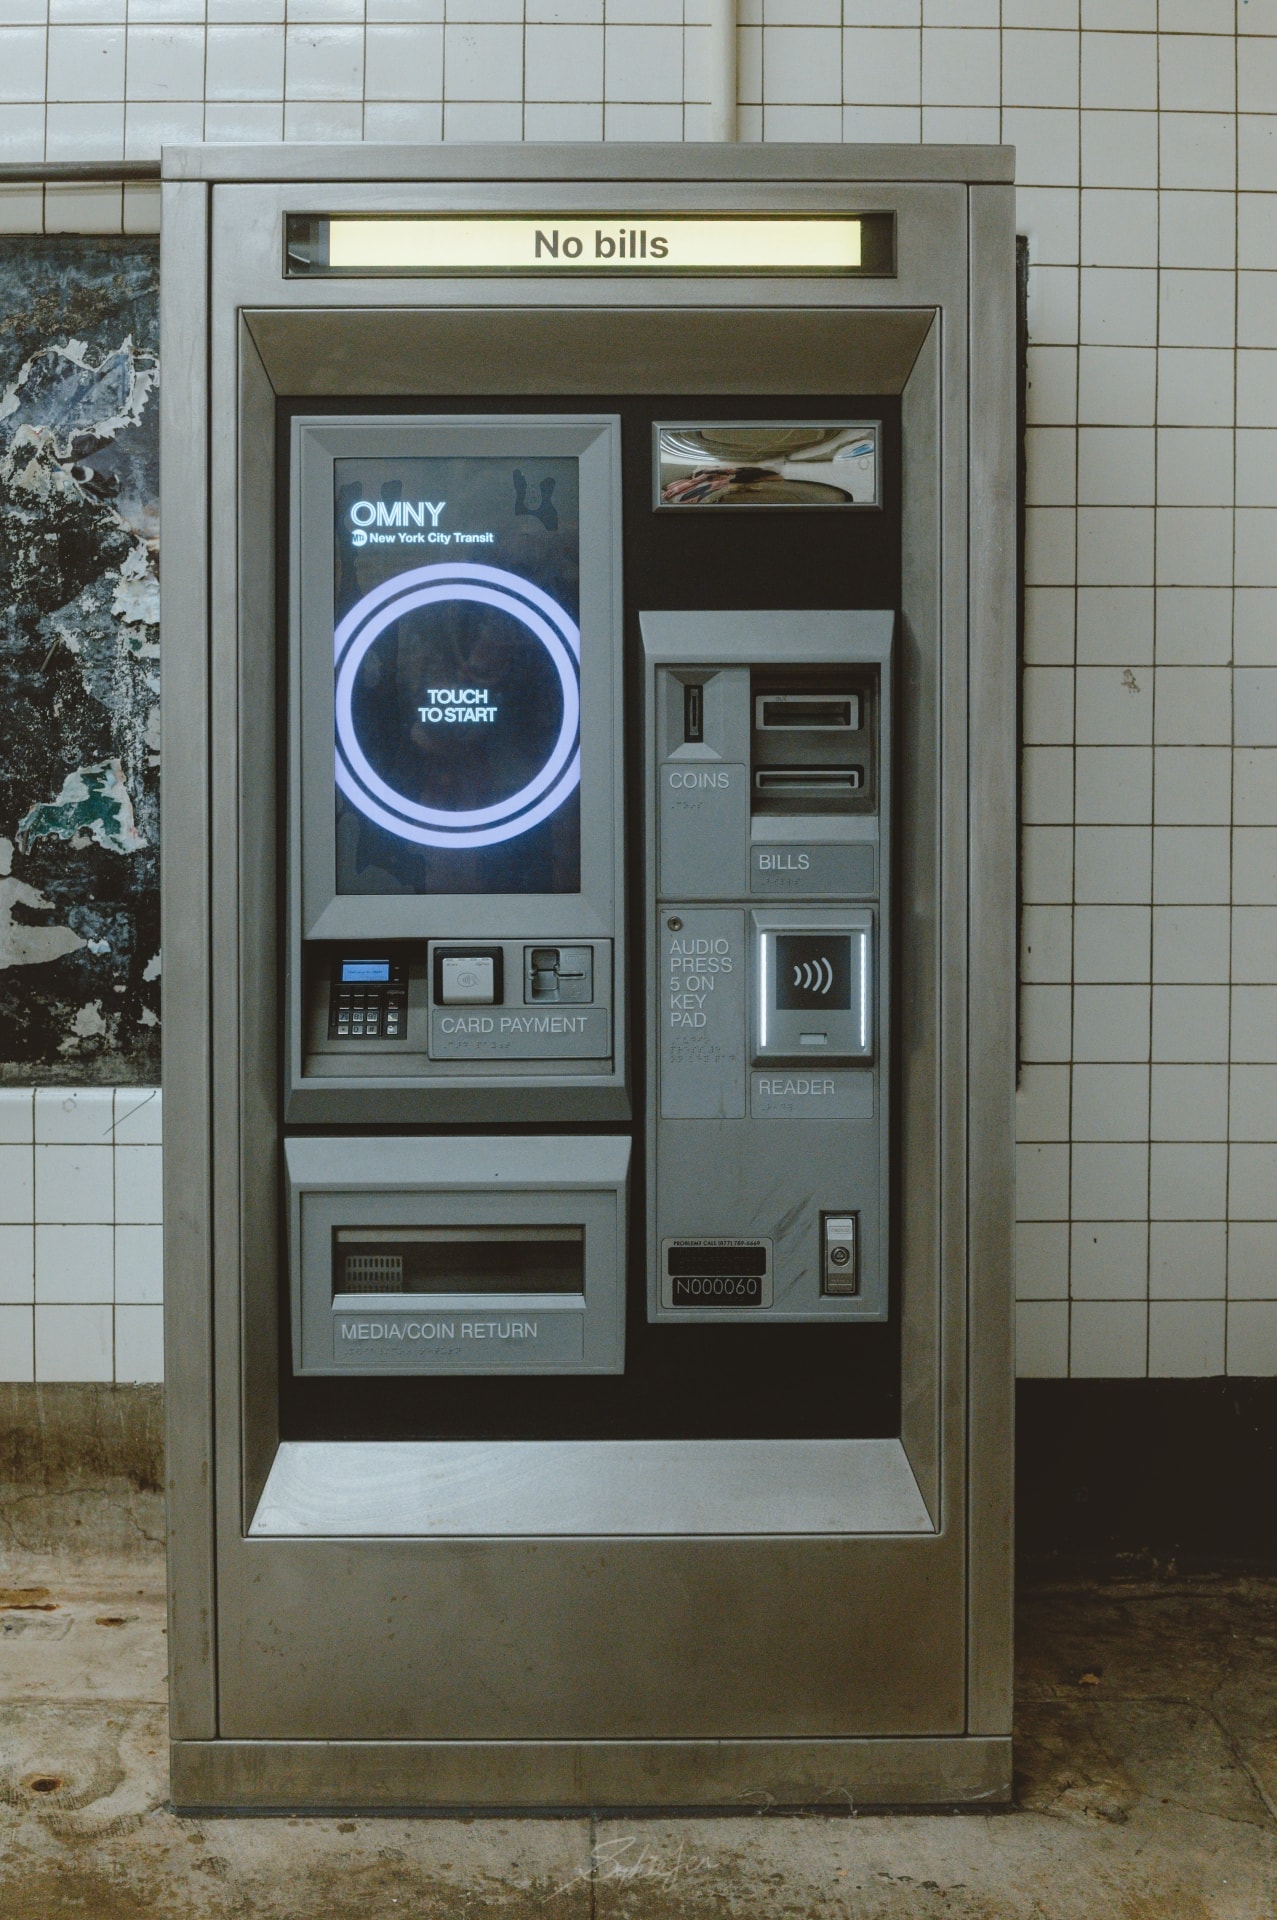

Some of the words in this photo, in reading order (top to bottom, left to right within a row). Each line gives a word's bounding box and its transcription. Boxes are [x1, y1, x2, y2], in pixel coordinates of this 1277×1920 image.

[535, 230, 583, 259] No
[595, 228, 669, 259] bills
[350, 501, 446, 527] OMNY
[369, 532, 395, 543] New
[397, 532, 425, 543] York
[428, 532, 450, 545] City
[453, 532, 494, 543] Transit
[427, 688, 488, 704] TOUCH
[417, 707, 443, 722] TO
[444, 707, 498, 722] START
[669, 772, 730, 789] COINS
[759, 854, 810, 870] BILLS
[669, 939, 729, 955] AUDIO
[670, 957, 733, 973] PRESS
[669, 976, 680, 992] 5
[686, 976, 715, 992] ON
[670, 994, 707, 1010] KEY
[441, 1017, 494, 1033] CARD
[500, 1017, 588, 1033] PAYMENT
[670, 1012, 707, 1028] PAD
[759, 1079, 836, 1095] READER
[677, 1278, 758, 1295] N000060
[341, 1323, 455, 1341] MEDIA/COIN
[461, 1322, 538, 1339] RETURN
